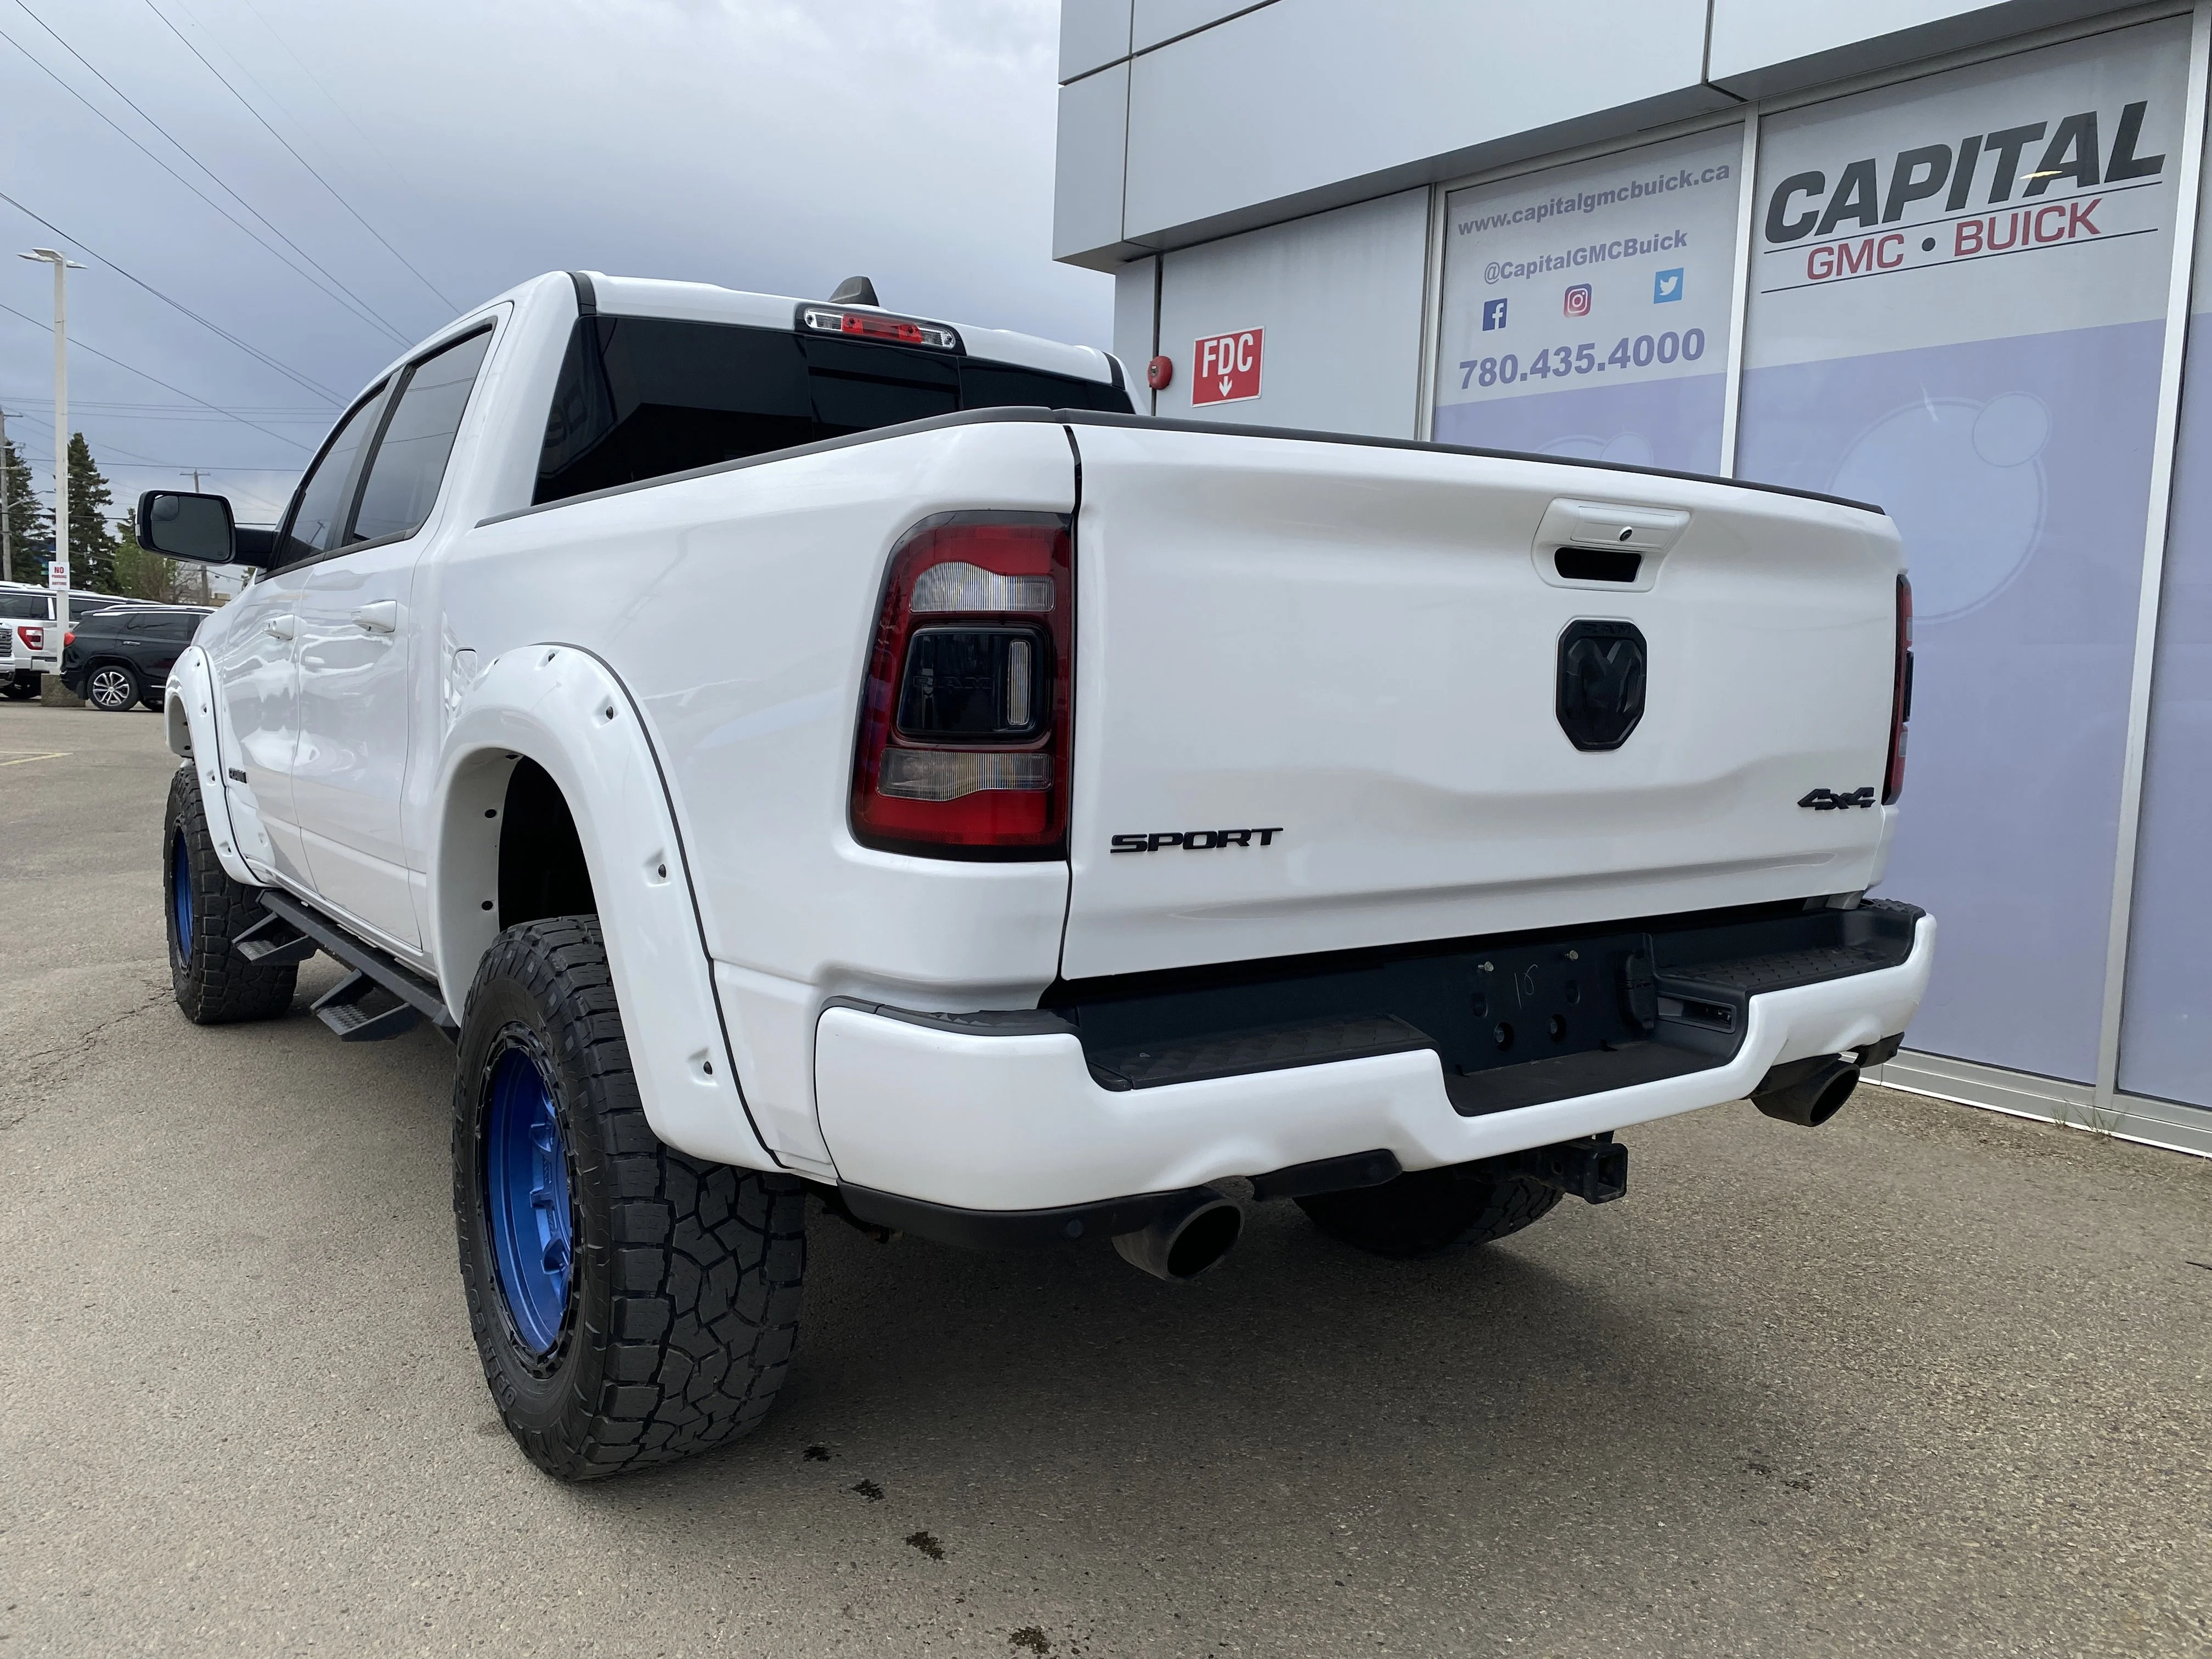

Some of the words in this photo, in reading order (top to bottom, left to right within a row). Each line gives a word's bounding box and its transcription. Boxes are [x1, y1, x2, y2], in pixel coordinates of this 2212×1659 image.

[1458, 165, 1730, 236] www.capitalgmcbuick.ca
[1765, 100, 2166, 244] CAPITAL
[1484, 229, 1688, 284] @CapitalGMCBuick
[1807, 234, 1905, 280] GMC
[1954, 198, 2102, 257] BUICK
[1202, 333, 1254, 378] FDC
[1459, 328, 1706, 390] 780.435.4000
[1110, 827, 1284, 853] SPORT
[483, 1338, 517, 1408] OPEN
